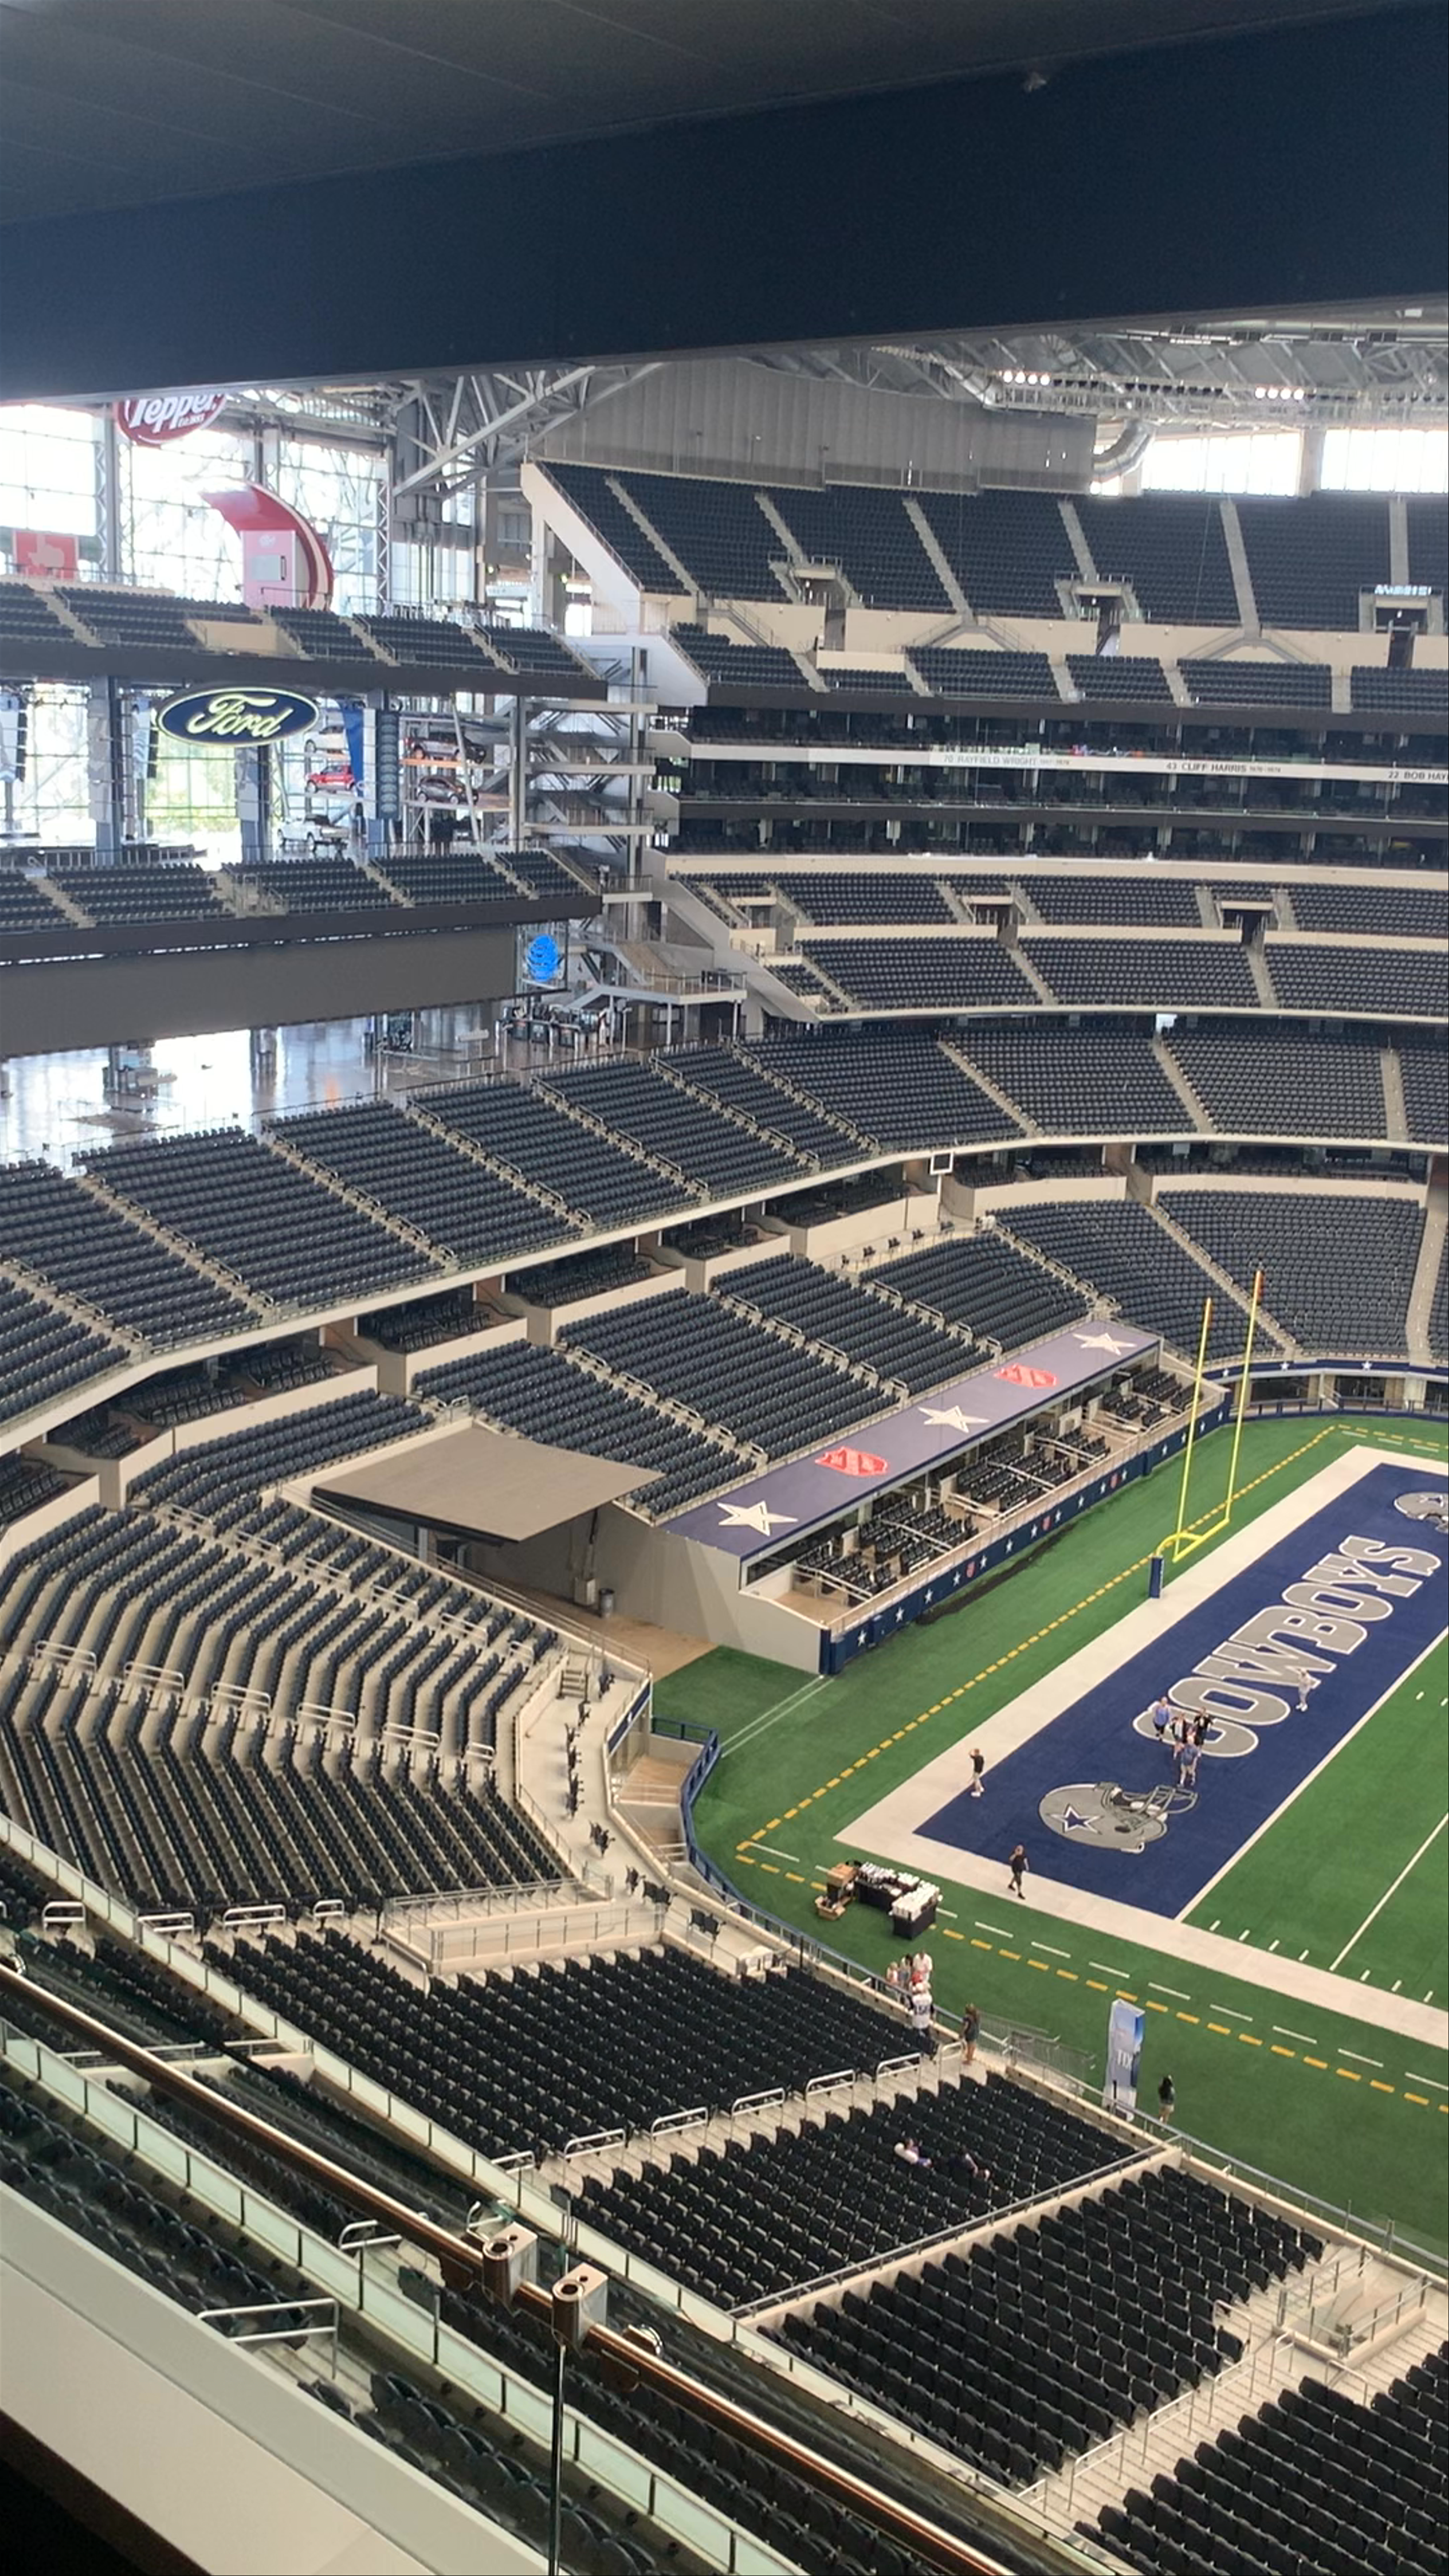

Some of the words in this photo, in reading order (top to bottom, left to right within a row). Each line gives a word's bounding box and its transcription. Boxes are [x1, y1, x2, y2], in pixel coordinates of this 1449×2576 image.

[187, 694, 293, 737] Ford
[1181, 762, 1207, 772] CLIFF
[1211, 764, 1247, 773] HARRIS
[1404, 771, 1425, 780] BOB
[1428, 772, 1449, 781] HAY
[1133, 1535, 1442, 1758] COWBOYS
